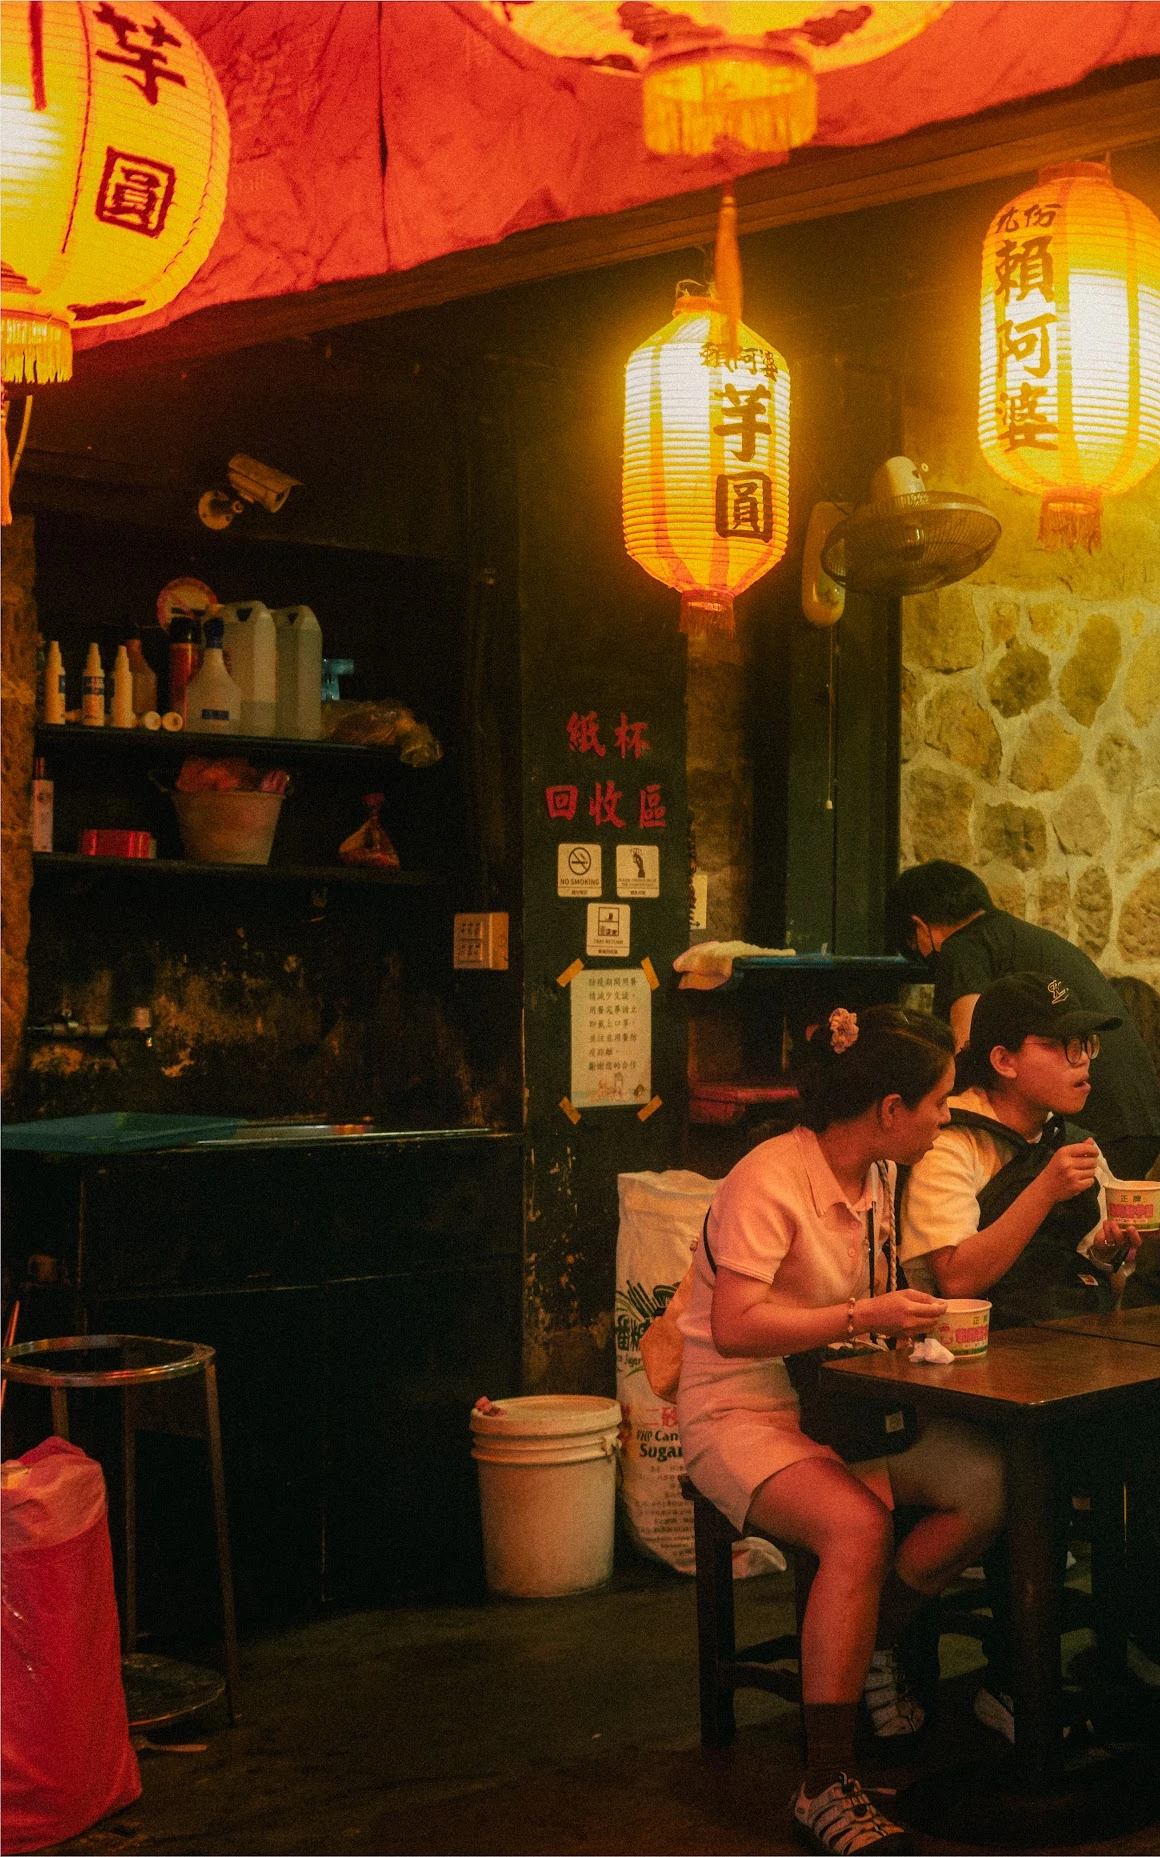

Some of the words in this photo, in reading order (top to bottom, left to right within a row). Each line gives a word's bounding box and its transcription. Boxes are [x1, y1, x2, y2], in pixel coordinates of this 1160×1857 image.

[92, 1, 187, 240] 芋圓
[995, 203, 1063, 234] 九份
[994, 235, 1061, 454] 賴阿婆
[712, 383, 774, 544] 芋圓
[566, 711, 651, 760] 紙杯
[545, 779, 668, 829] 回收區
[570, 878, 600, 886] SMOKING
